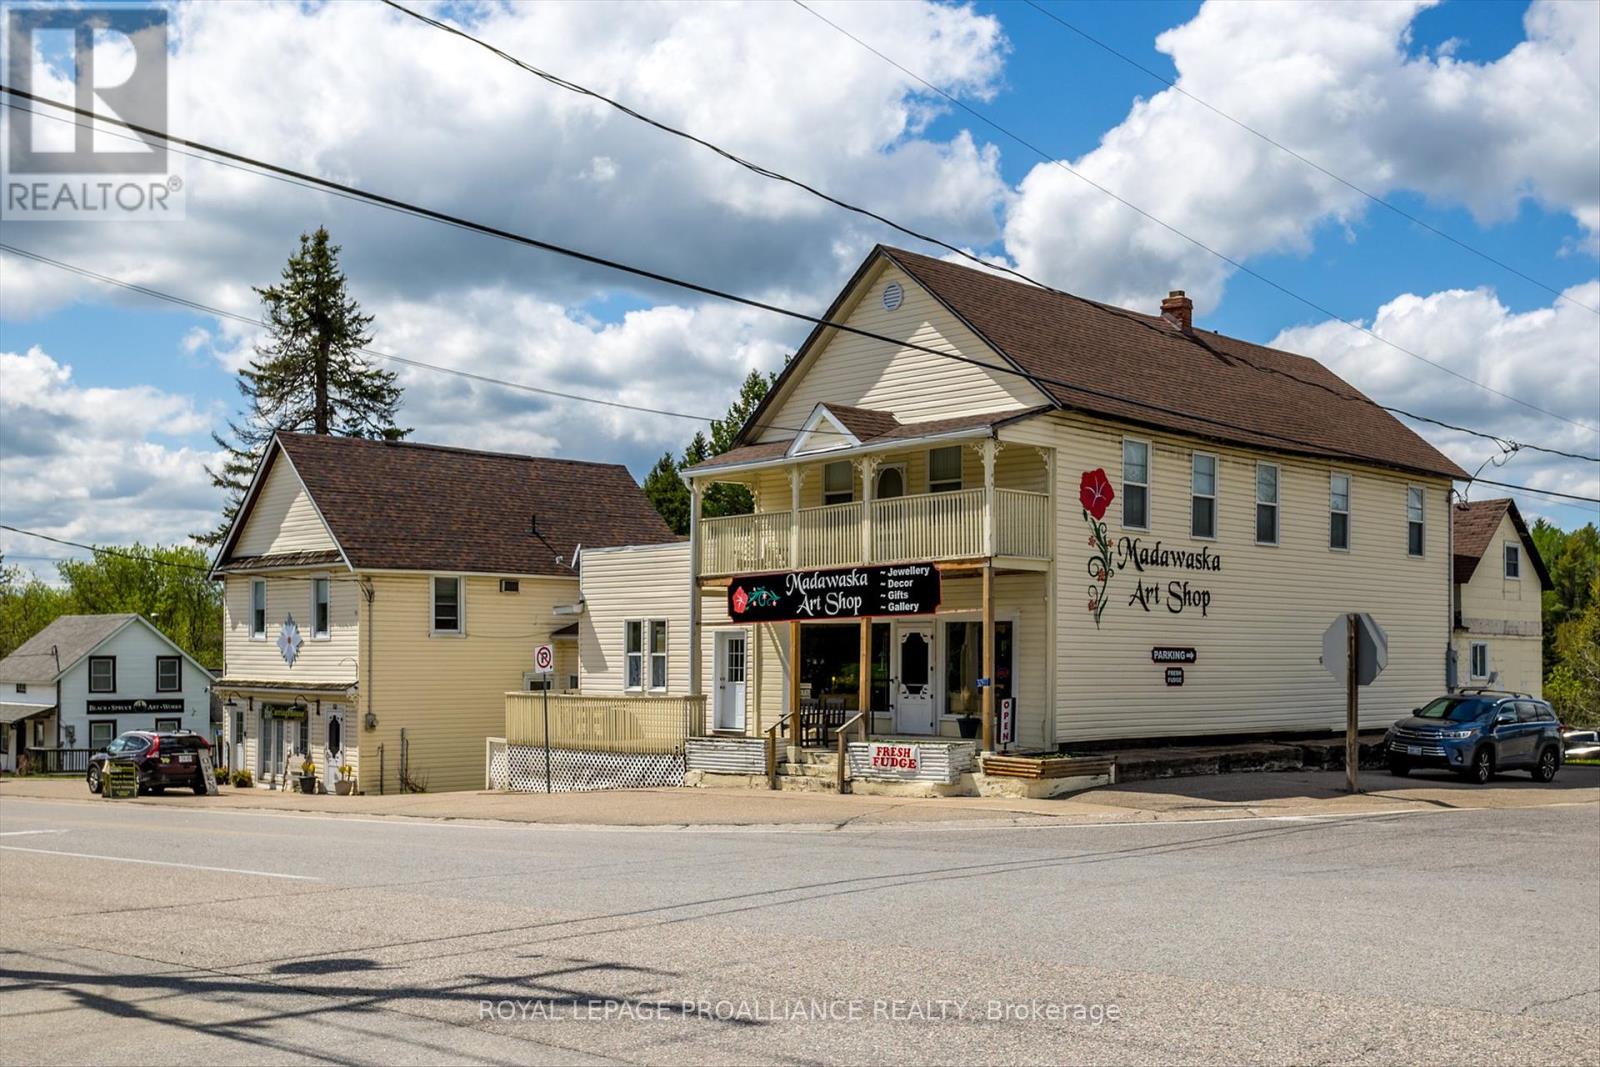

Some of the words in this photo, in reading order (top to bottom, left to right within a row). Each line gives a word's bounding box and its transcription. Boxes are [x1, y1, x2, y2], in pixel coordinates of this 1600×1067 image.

[1117, 536, 1221, 572] Madawaska
[887, 566, 930, 577] Jewellery
[785, 568, 869, 596] Madawaska
[887, 579, 913, 588] Decor
[887, 590, 909, 600] Gifts
[1128, 577, 1160, 612] Art
[1166, 581, 1211, 617] Shop
[796, 593, 822, 617] Art
[825, 591, 862, 616] Shop
[887, 602, 920, 612] Gallery
[1153, 650, 1186, 660] PARKING
[876, 746, 911, 758] FRESH
[872, 756, 917, 769] FUDGE
